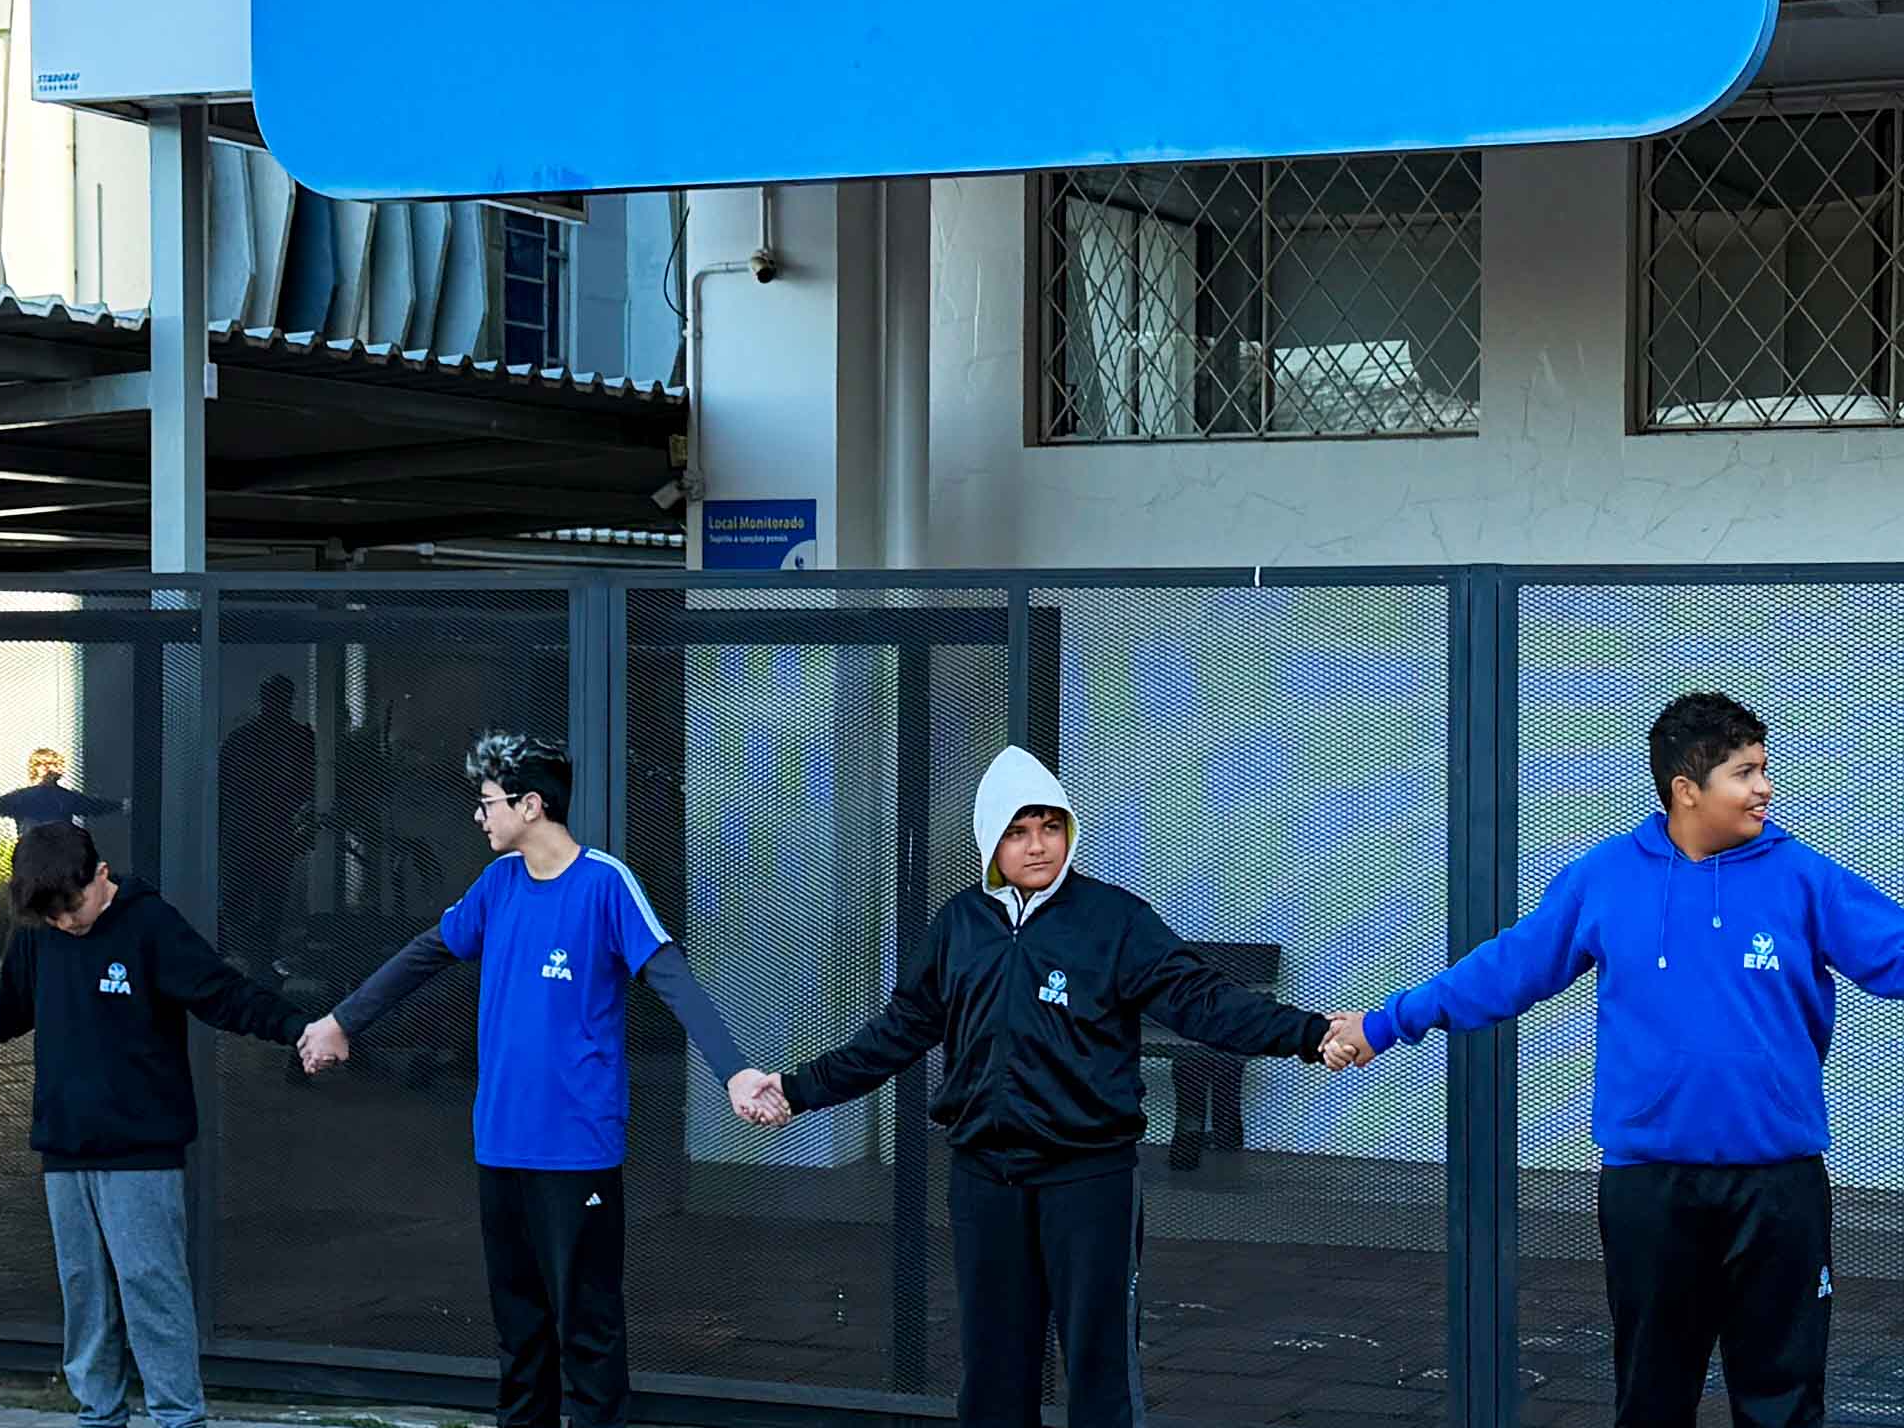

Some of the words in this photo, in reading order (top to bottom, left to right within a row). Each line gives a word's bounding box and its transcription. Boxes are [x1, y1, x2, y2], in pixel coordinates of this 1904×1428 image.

[708, 516, 737, 529] Local
[739, 516, 805, 529] Monitorado
[1743, 953, 1780, 971] EFA
[541, 964, 572, 981] EFA
[99, 978, 132, 995] EFA
[1038, 986, 1068, 1006] EFA
